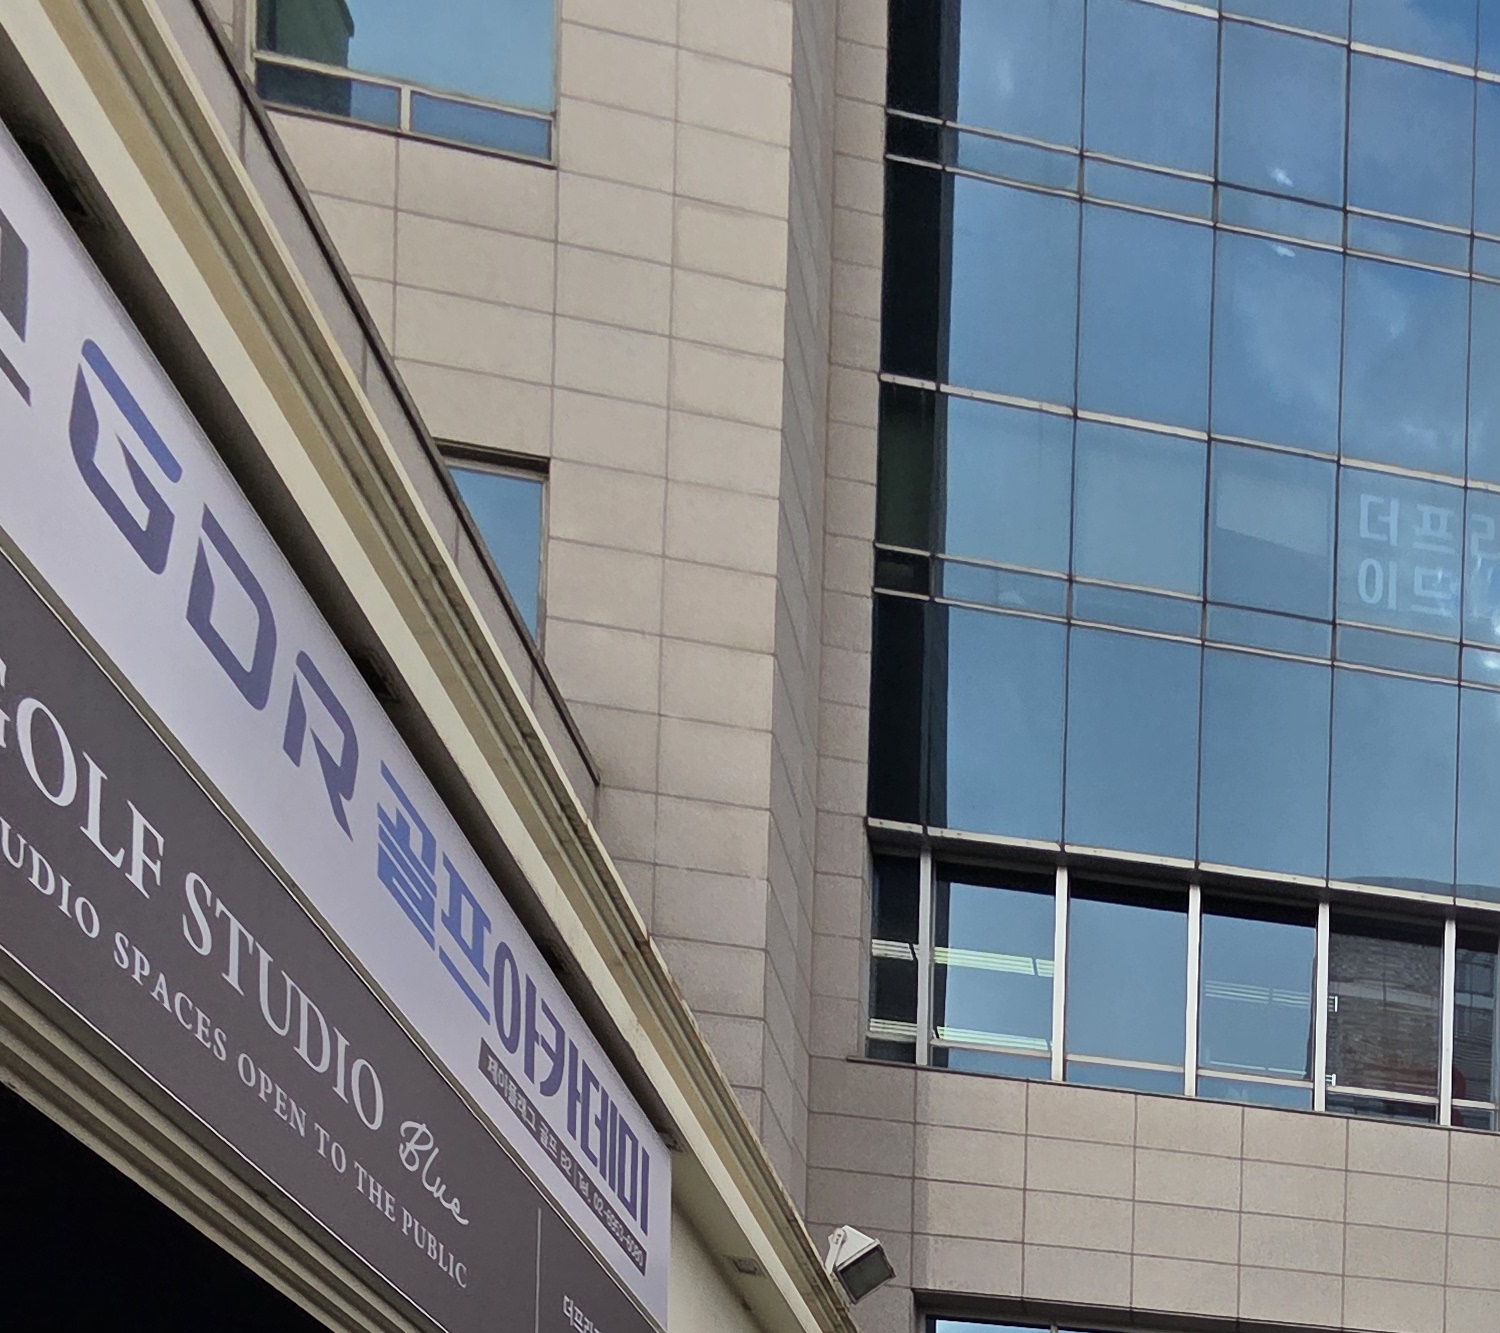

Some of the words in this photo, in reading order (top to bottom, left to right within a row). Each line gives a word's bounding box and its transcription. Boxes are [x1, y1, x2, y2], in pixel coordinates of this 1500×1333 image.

[69, 338, 359, 841] GDR
[377, 760, 650, 1237] 골프아카데미
[113, 931, 227, 1062] SPACES
[237, 1053, 307, 1138] OPEN
[313, 1122, 347, 1174] TO
[353, 1160, 397, 1222] THE
[402, 1207, 468, 1289] PUBLIC
[183, 872, 384, 1131] STUDIO
[399, 1120, 470, 1226] Blue
[540, 1121, 558, 1159] 골프
